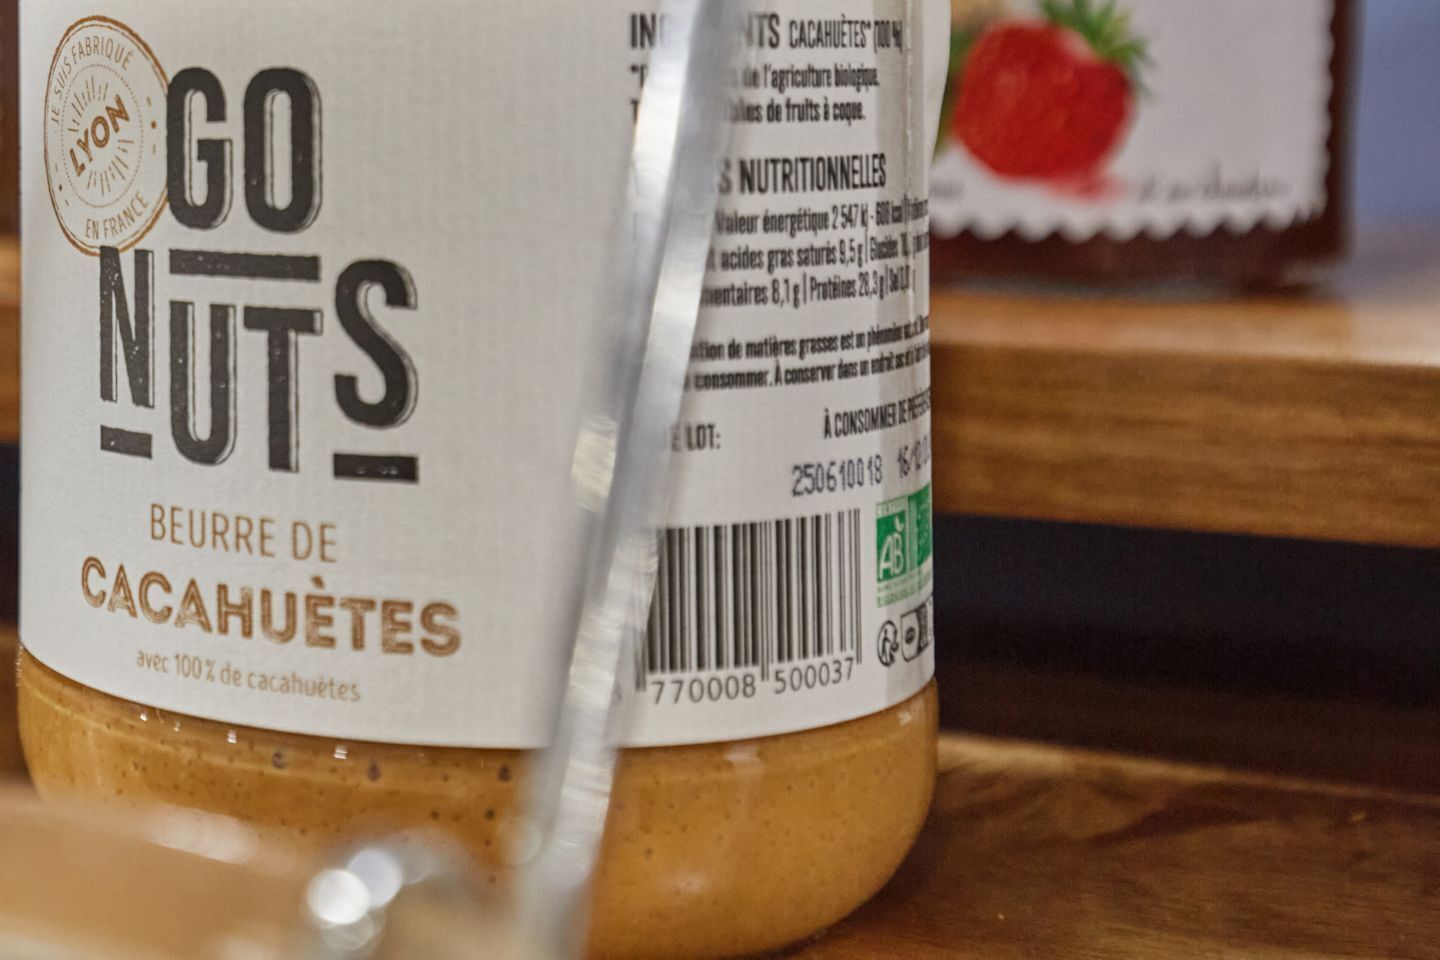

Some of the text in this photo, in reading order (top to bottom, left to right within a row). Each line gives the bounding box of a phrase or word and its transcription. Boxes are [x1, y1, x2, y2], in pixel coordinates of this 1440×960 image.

[72, 35, 134, 71] FABRIQUÉ
[766, 98, 783, 123] de
[785, 97, 820, 123] fruits
[69, 94, 131, 177] LYON
[166, 66, 323, 233] GO
[739, 152, 887, 195] NUTRITIONNELLES
[85, 190, 150, 240] EN FRANCE
[763, 206, 829, 239] énergétique
[720, 245, 765, 271] acides
[767, 248, 794, 275] gras
[796, 240, 837, 268] saturés
[100, 246, 418, 472] NUTS
[727, 337, 742, 360] de
[784, 364, 836, 385] conserver
[834, 401, 897, 438] CONSOMMER
[150, 503, 338, 563] BEURRE DE
[80, 555, 462, 657] CACAHUÈTES
[136, 649, 169, 673] avec
[220, 662, 243, 688] de
[651, 656, 854, 705] 770008 500037
